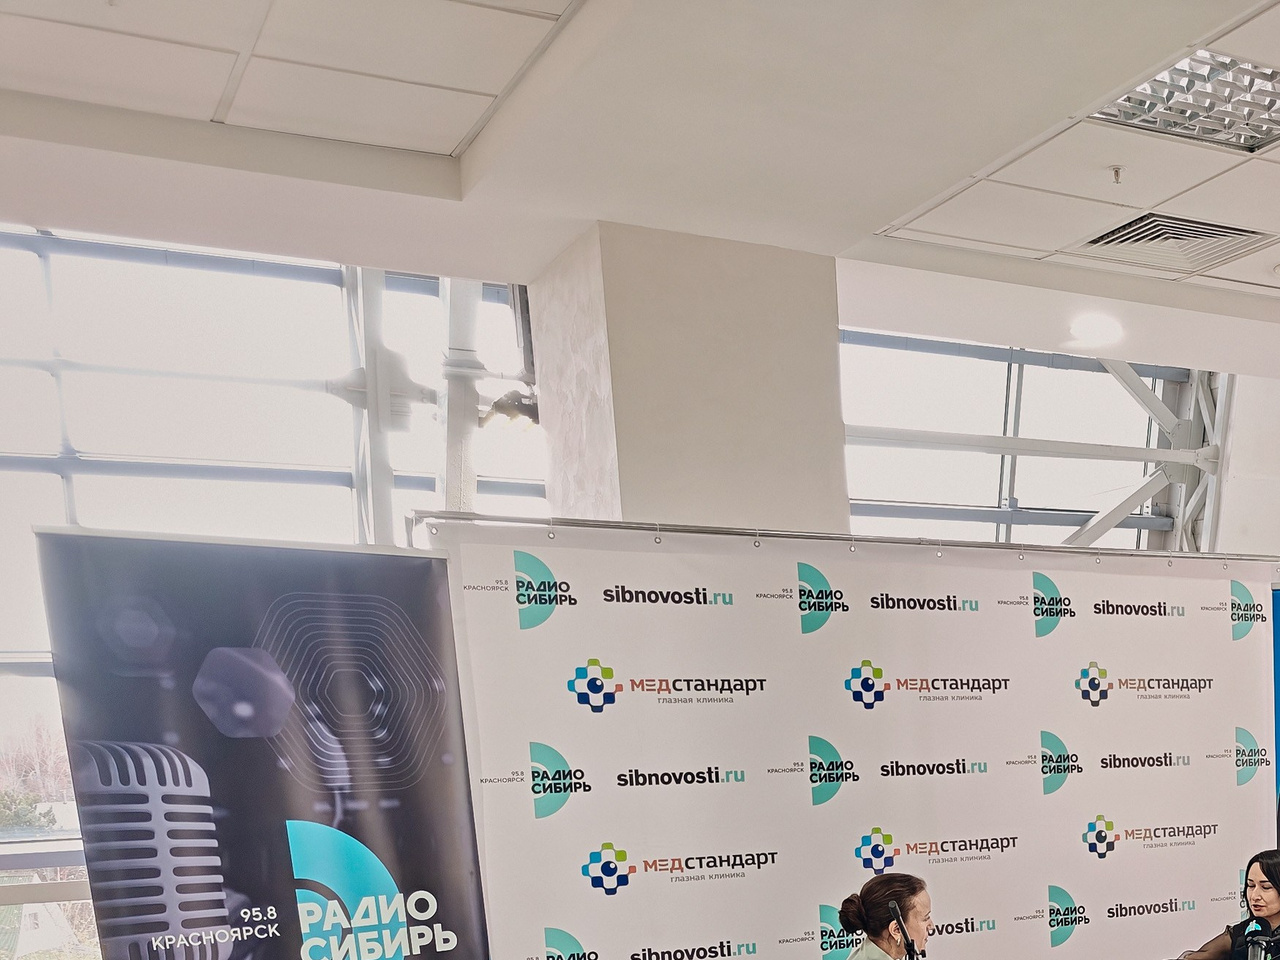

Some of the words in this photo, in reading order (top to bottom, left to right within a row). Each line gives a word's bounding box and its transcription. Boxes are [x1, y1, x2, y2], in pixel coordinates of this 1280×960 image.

[463, 584, 510, 592] КРАСНОЯРСК
[516, 580, 571, 593] РАДИО
[515, 592, 578, 606] СИБИРЬ
[603, 585, 734, 606] sibnovosti.ru
[798, 588, 843, 600] РАДИО
[798, 600, 850, 613] СИБИРЬ
[870, 593, 979, 613] sibnovosti.ru
[1033, 596, 1072, 608] РАДИО
[1231, 602, 1264, 613] РАДИО
[1033, 607, 1076, 619] СИБИРЬ
[1093, 600, 1185, 618] sibnovosti.ru
[1230, 612, 1267, 623] СИБИРЬ
[1041, 753, 1079, 765] РАДИО
[1236, 748, 1267, 758] РАДИО
[809, 760, 854, 772] РАДИО
[1100, 753, 1191, 770] sibnovosti.ru
[1235, 757, 1271, 768] СИБИРЬ
[767, 767, 805, 775] КРАСНОЯРСК
[880, 759, 988, 778] sibnovosti.ru
[1041, 763, 1083, 776] СИБИРЬ
[479, 776, 525, 784] КРАСНОЯРСК
[531, 769, 585, 782] РАДИО
[616, 767, 746, 787] sibnovosti.ru
[809, 771, 860, 784] СИБИРЬ
[531, 781, 592, 795] СИБИРЬ
[1143, 842, 1168, 850] глазная
[928, 856, 958, 865] глазная
[960, 854, 991, 862] клиника
[670, 874, 706, 883] глазная
[708, 872, 746, 880] клиника
[240, 906, 278, 923] 95.8
[297, 890, 438, 934] РАДИО
[1048, 905, 1086, 917] РАДИО
[1107, 898, 1196, 919] sibnovosti.ru
[1048, 914, 1090, 929] СИБИРЬ
[151, 923, 281, 951] КРАСНОЯРСК
[820, 938, 865, 951] СИБИР
